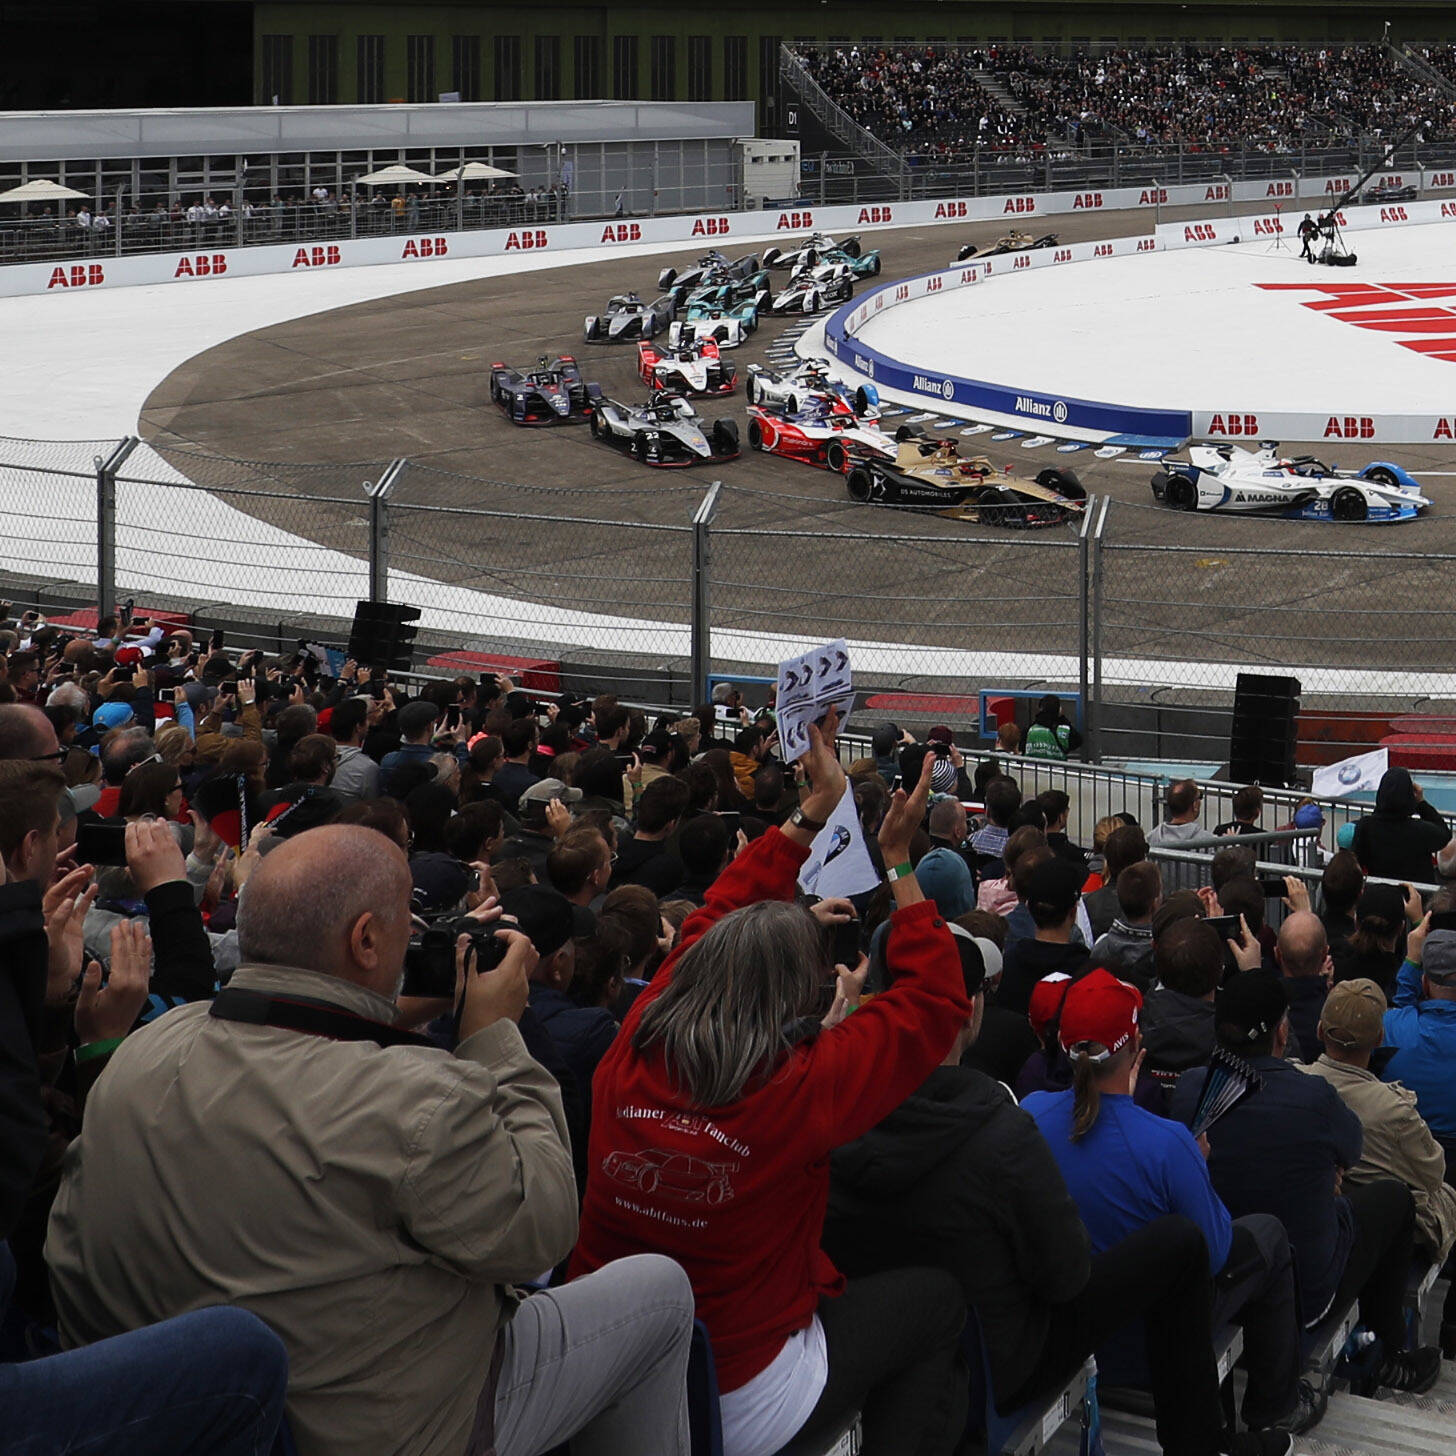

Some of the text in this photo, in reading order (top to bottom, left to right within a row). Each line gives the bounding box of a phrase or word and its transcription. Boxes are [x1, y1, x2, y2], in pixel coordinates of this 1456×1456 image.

[47, 264, 104, 288] ABB
[174, 254, 227, 278] ABB
[292, 245, 340, 268] ABB
[402, 237, 448, 258] ABB
[504, 230, 548, 250] ABB
[601, 224, 641, 243] ABB
[692, 218, 730, 236] ABB
[777, 212, 813, 230] ABB
[858, 207, 892, 224] ABB
[934, 202, 968, 219] ABB
[1003, 197, 1036, 214] ABB
[1073, 193, 1104, 209] ABB
[1266, 183, 1292, 196] ABB
[1325, 179, 1351, 193] ABB
[1432, 173, 1455, 187] ABB
[1184, 224, 1216, 242] ABB
[1254, 218, 1283, 235] ABB
[1380, 206, 1408, 222] ABB
[1053, 248, 1072, 262] ABB
[1094, 243, 1113, 257] ABB
[913, 375, 942, 394] Allianz
[1015, 396, 1051, 416] Allianz
[1208, 414, 1259, 436] ABB
[1323, 417, 1375, 438] ABB
[1247, 494, 1290, 503] MAGNA
[1113, 1032, 1129, 1052] AVIS
